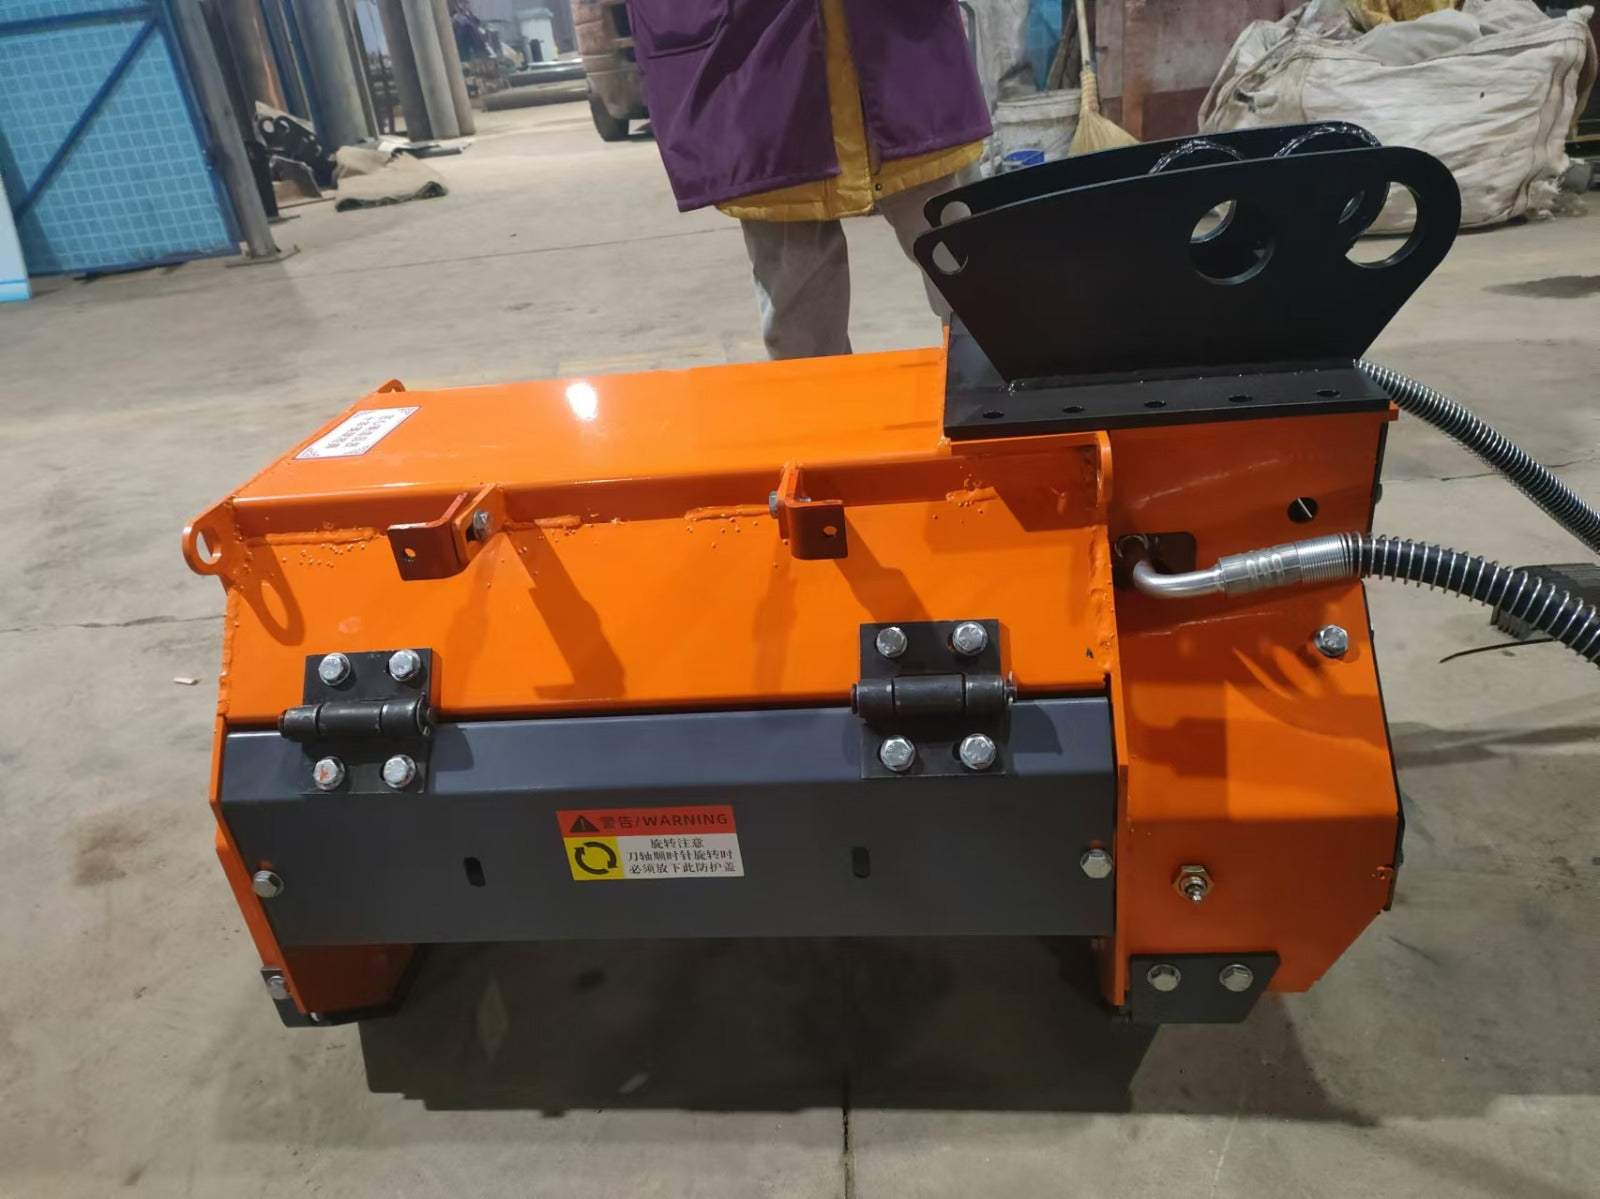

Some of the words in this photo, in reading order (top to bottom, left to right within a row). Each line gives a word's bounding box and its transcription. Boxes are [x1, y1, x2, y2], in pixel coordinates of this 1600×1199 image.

[650, 837, 704, 849] 旋转注意
[628, 849, 732, 861] 刀轴顺时针旋转时
[629, 861, 736, 874] 必须放下此防护盖
